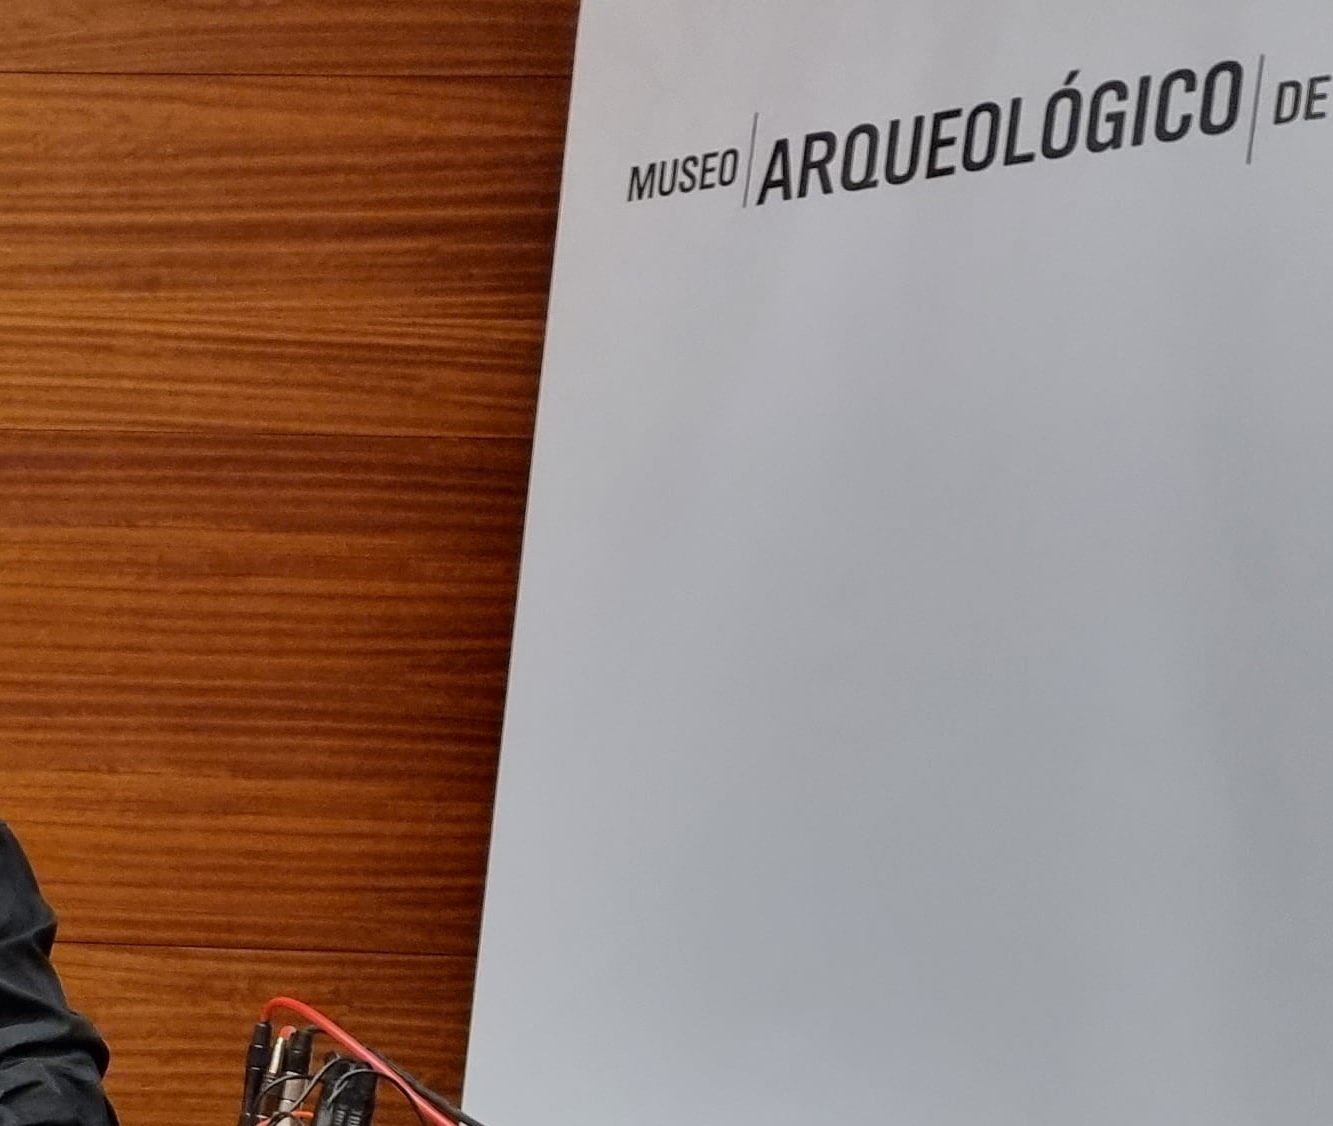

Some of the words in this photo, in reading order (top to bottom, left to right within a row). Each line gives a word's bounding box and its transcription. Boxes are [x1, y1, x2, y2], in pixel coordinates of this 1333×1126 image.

[627, 148, 739, 202] MUSEO
[756, 60, 1244, 206] ARQUEOLÓGICO
[1273, 74, 1332, 125] DE
